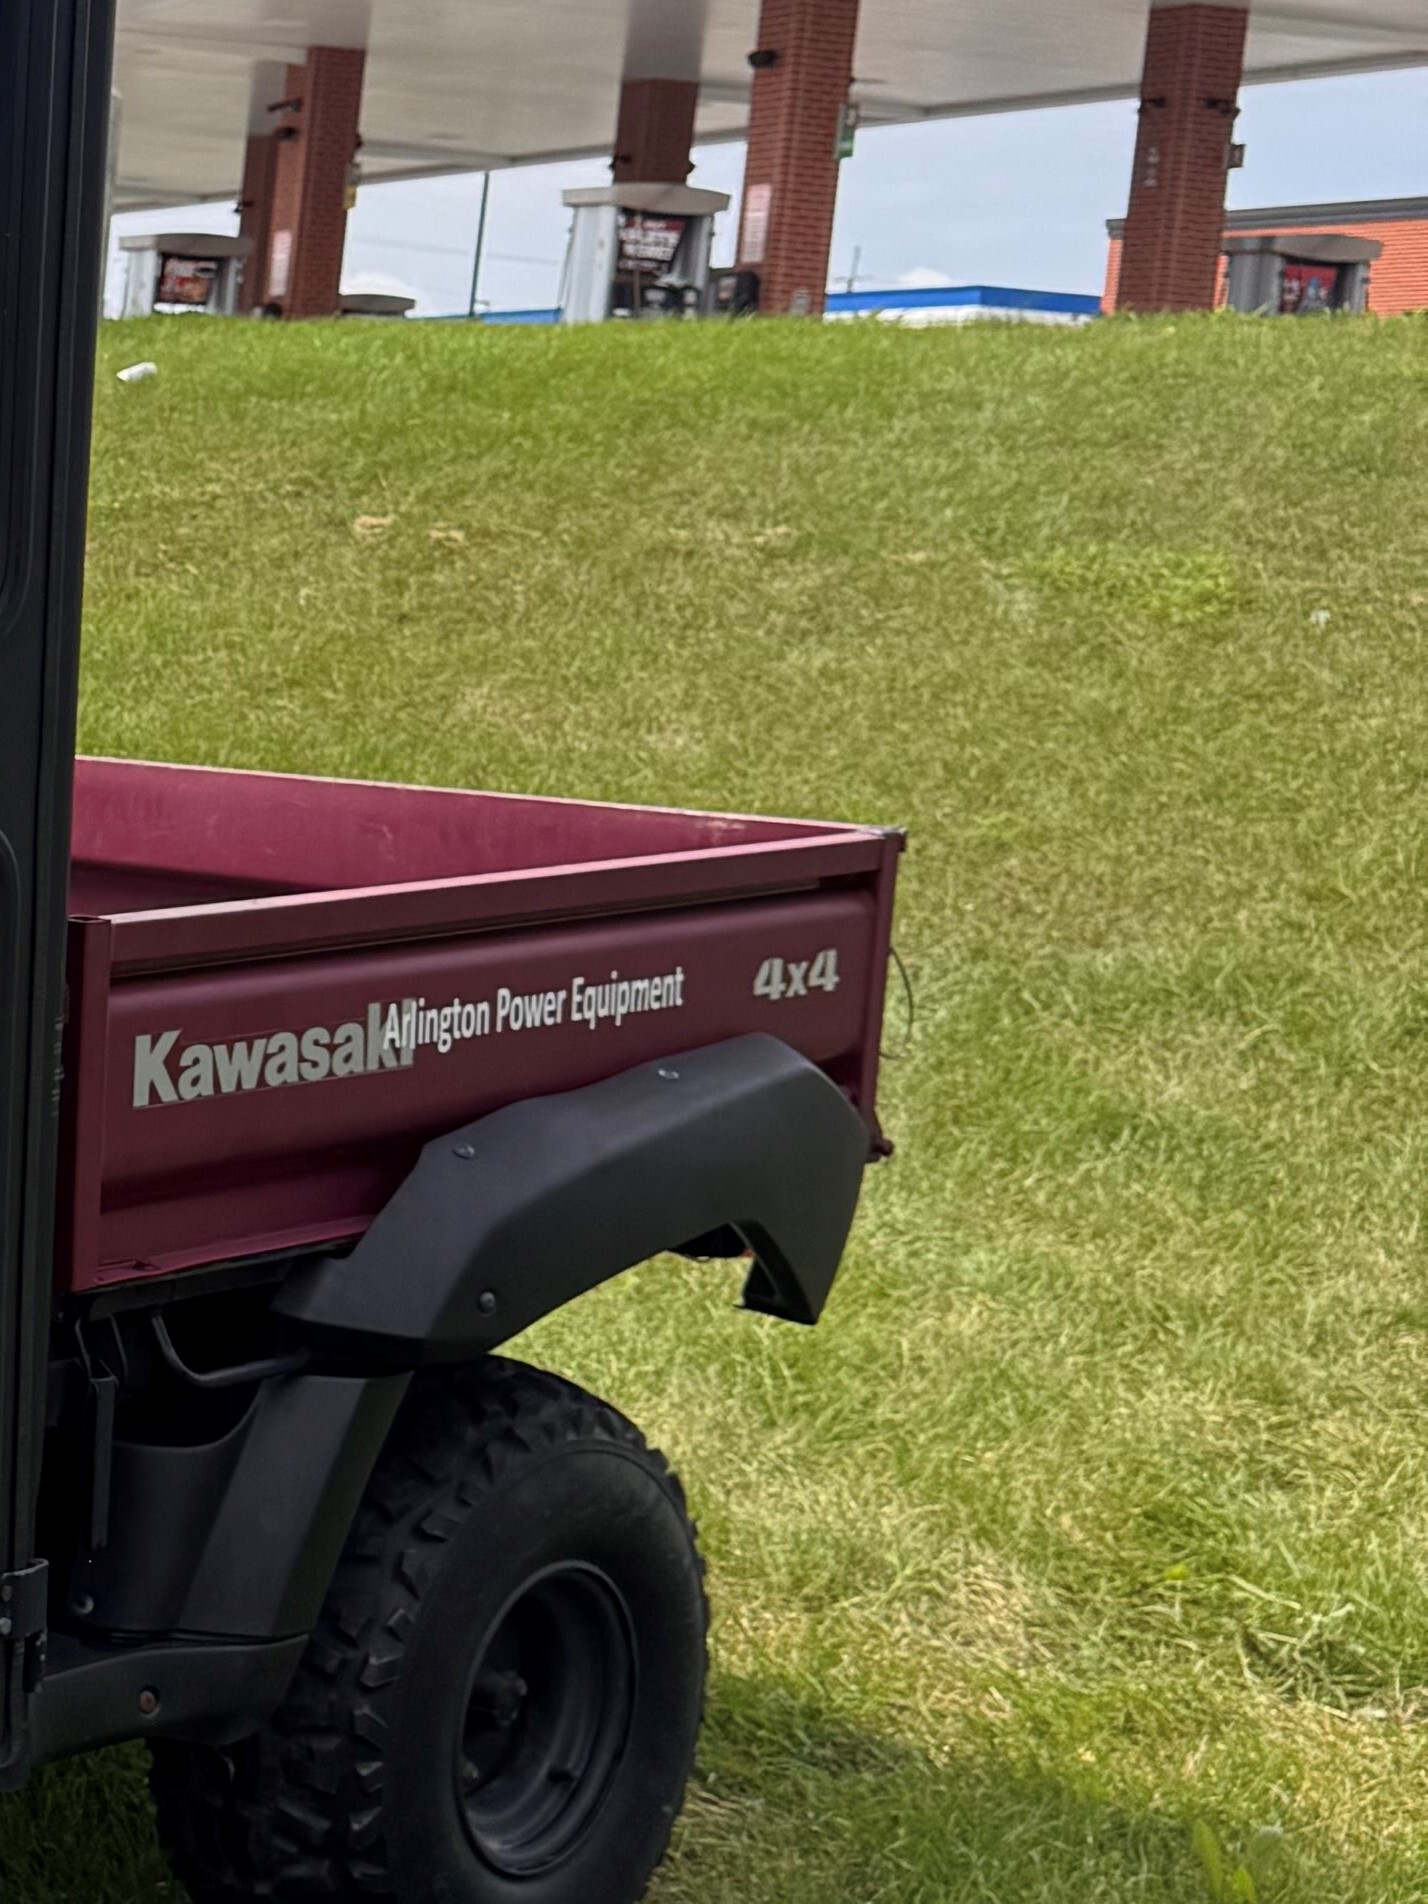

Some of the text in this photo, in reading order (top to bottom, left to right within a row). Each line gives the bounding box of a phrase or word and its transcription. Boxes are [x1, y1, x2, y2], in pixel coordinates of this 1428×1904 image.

[382, 966, 685, 1054] Arlington Power Equipment
[753, 948, 840, 1000] 4x4
[133, 998, 415, 1108] Kawasaki
